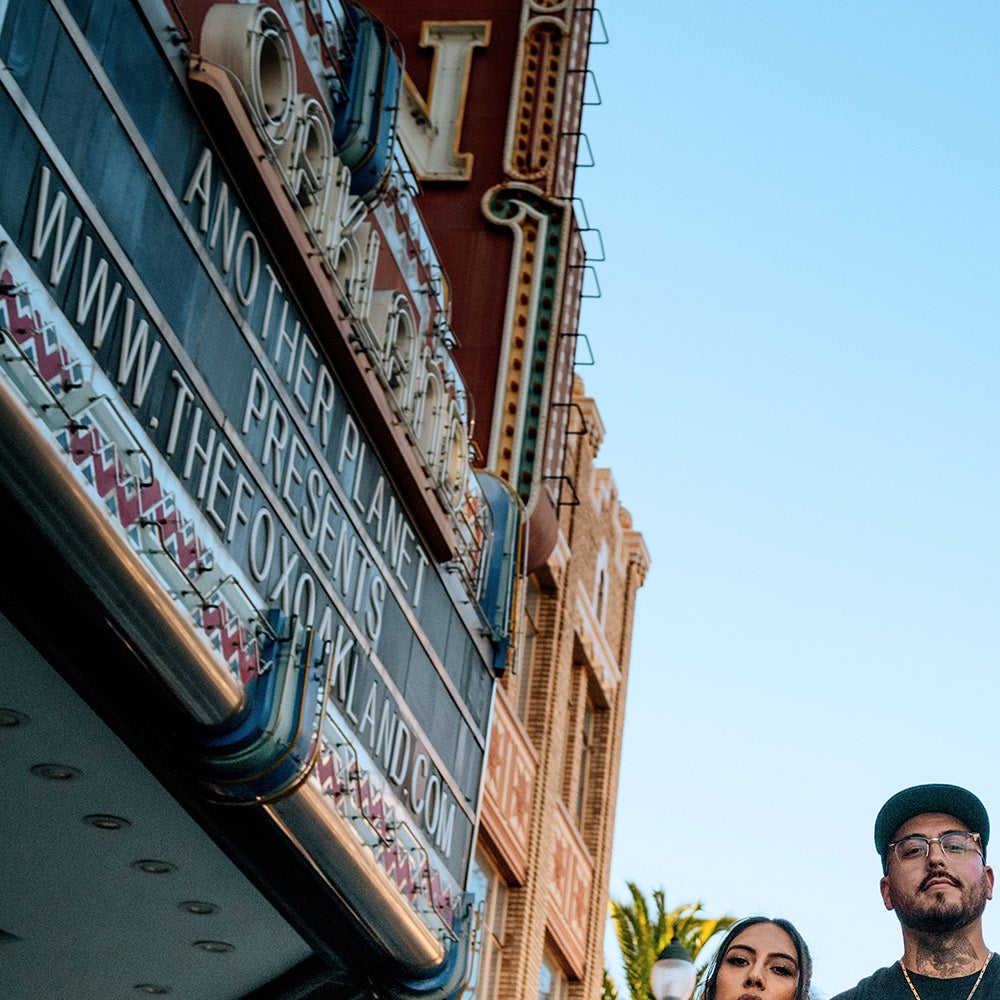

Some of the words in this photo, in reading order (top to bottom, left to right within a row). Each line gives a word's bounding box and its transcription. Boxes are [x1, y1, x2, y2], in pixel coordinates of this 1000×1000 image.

[183, 147, 335, 447] ANOTHER
[338, 414, 429, 608] PLANET
[242, 367, 386, 642] PRESENTS
